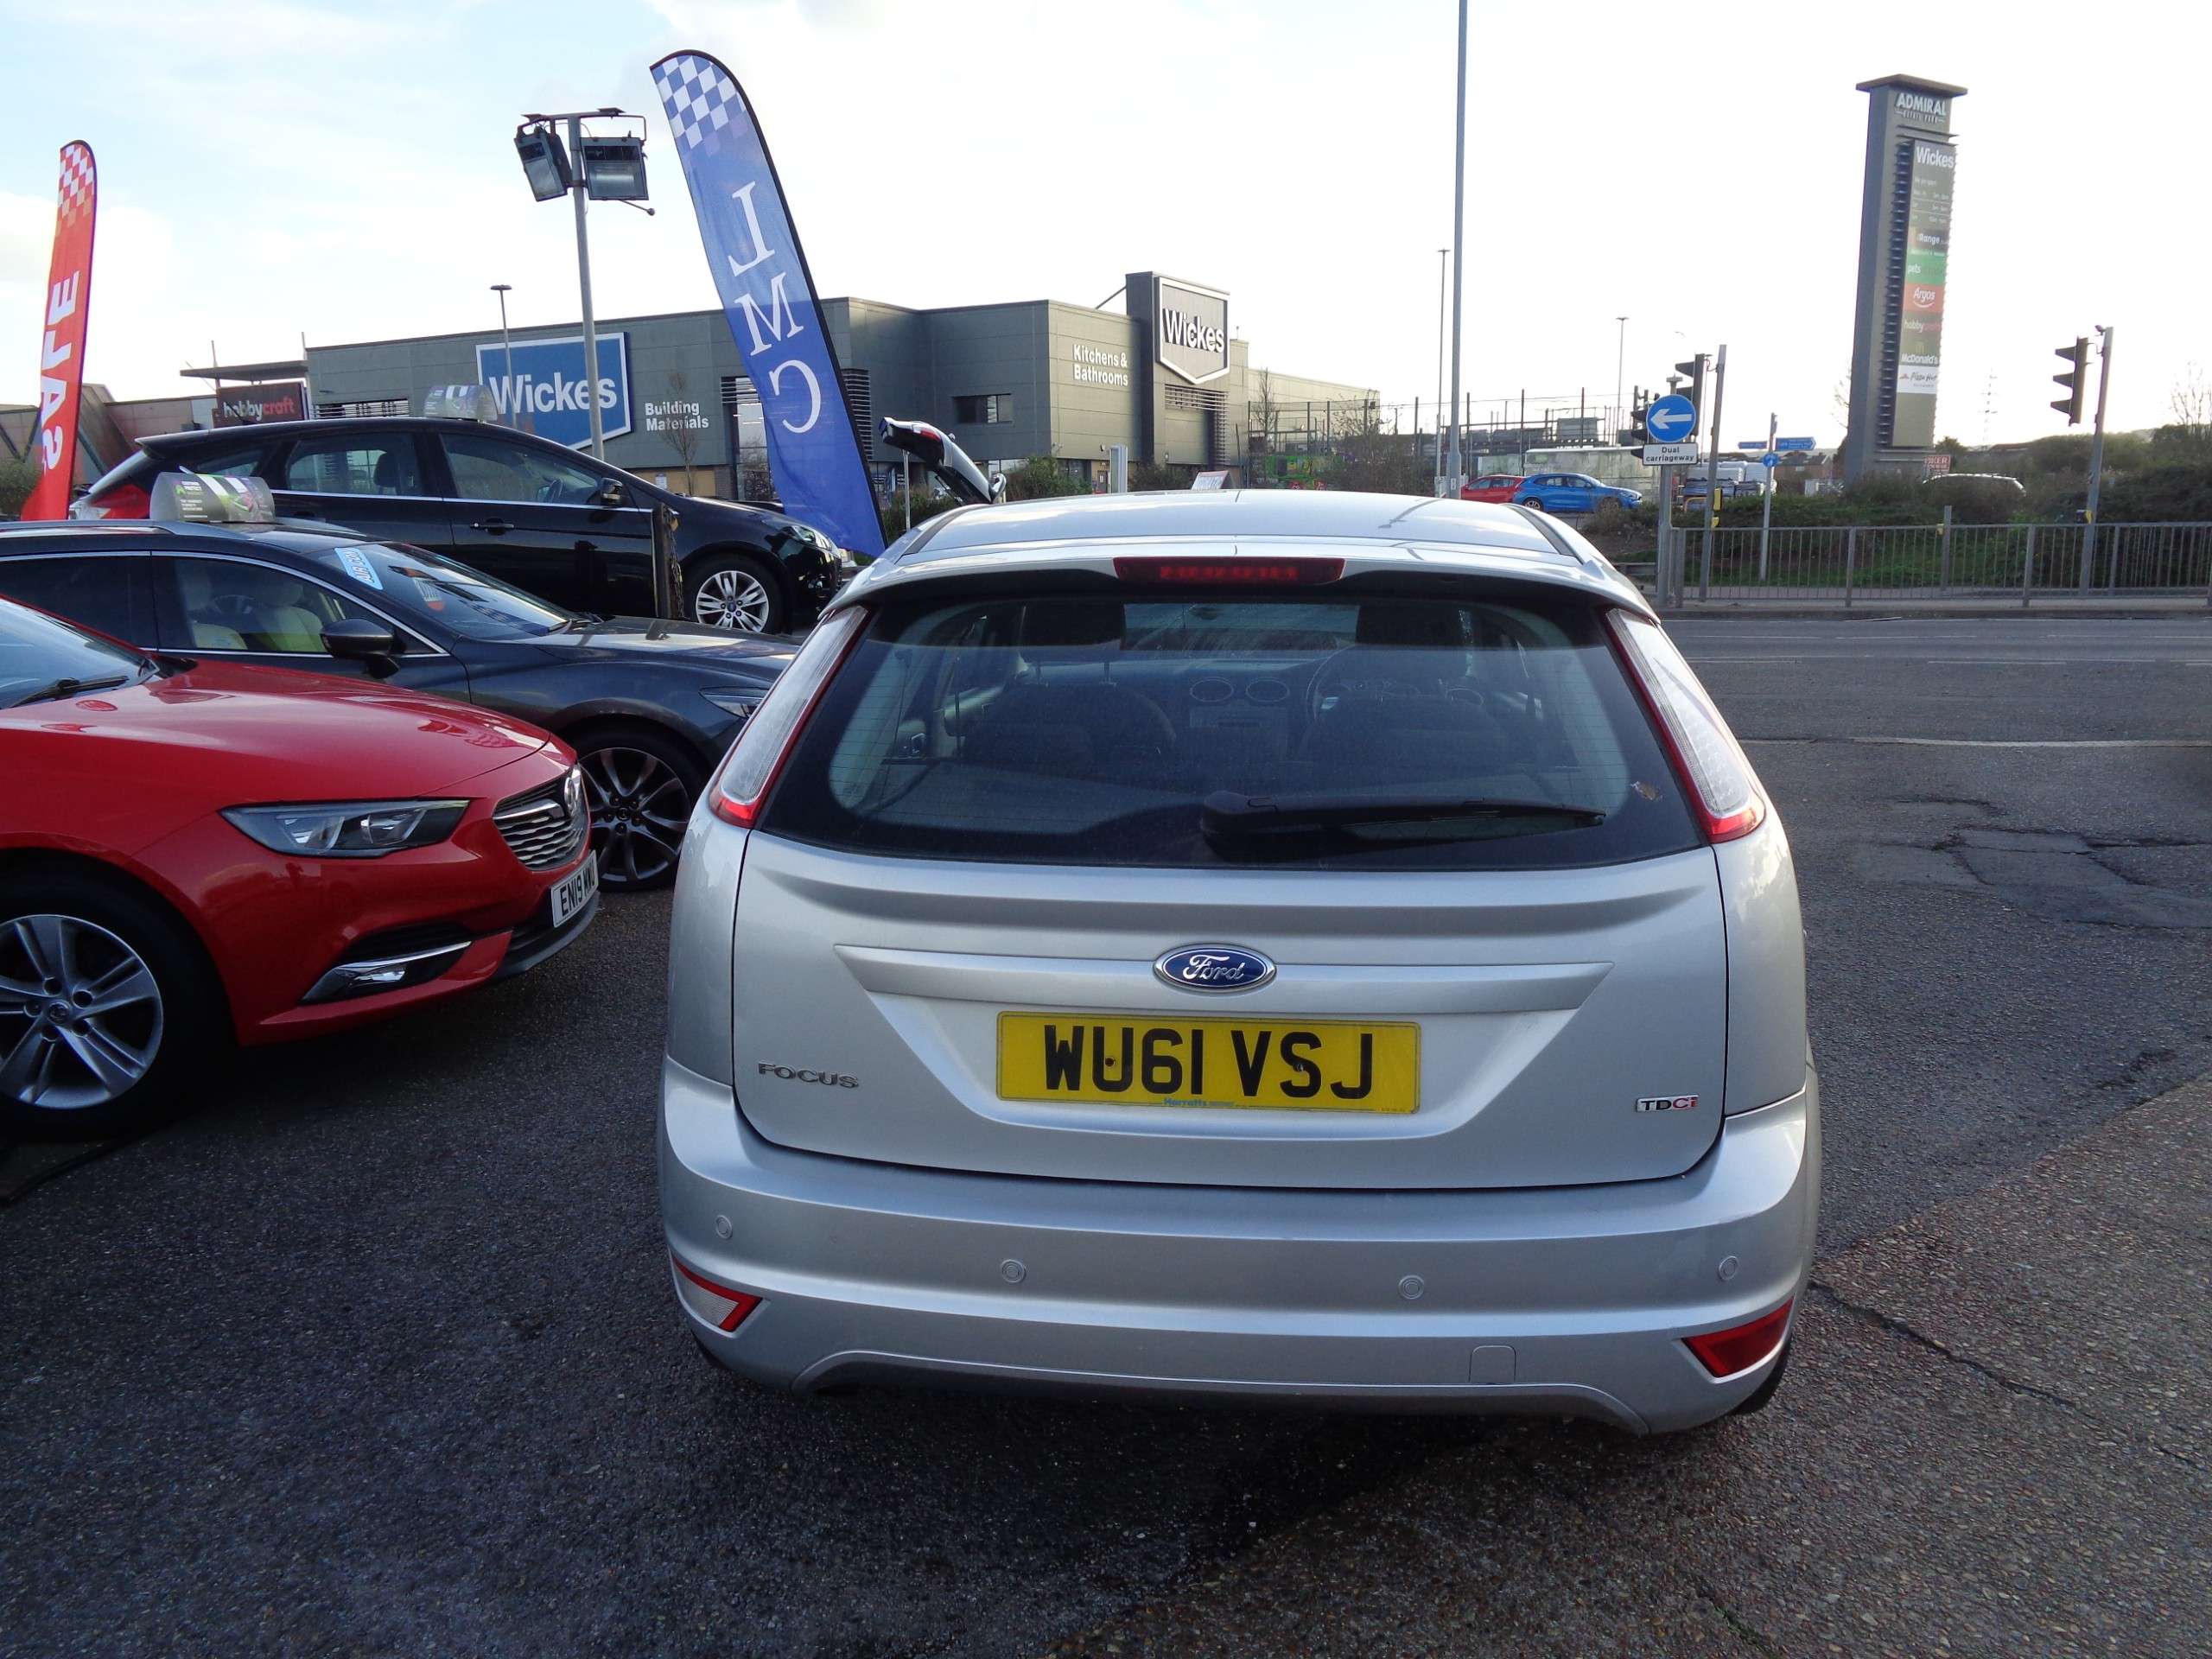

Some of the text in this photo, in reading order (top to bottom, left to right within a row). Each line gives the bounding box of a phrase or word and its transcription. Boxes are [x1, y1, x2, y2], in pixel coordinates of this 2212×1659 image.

[1897, 92, 1946, 115] ADMIRAL
[1916, 146, 1955, 168] Wickes
[1913, 287, 1936, 302] Argos
[1164, 308, 1224, 353] Wickes
[1904, 320, 1940, 333] hobby
[1073, 344, 1128, 368] Kitchens &
[1073, 364, 1128, 386] Bathrooms
[489, 372, 617, 415] Wickes
[223, 397, 295, 421] hobbycraft
[645, 401, 700, 416] Building
[646, 416, 709, 432] Materials
[560, 875, 582, 917] EN19
[1182, 954, 1245, 982] Ford
[1044, 1025, 1373, 1099] WU61 VSJ
[758, 1061, 859, 1088] FOCUS
